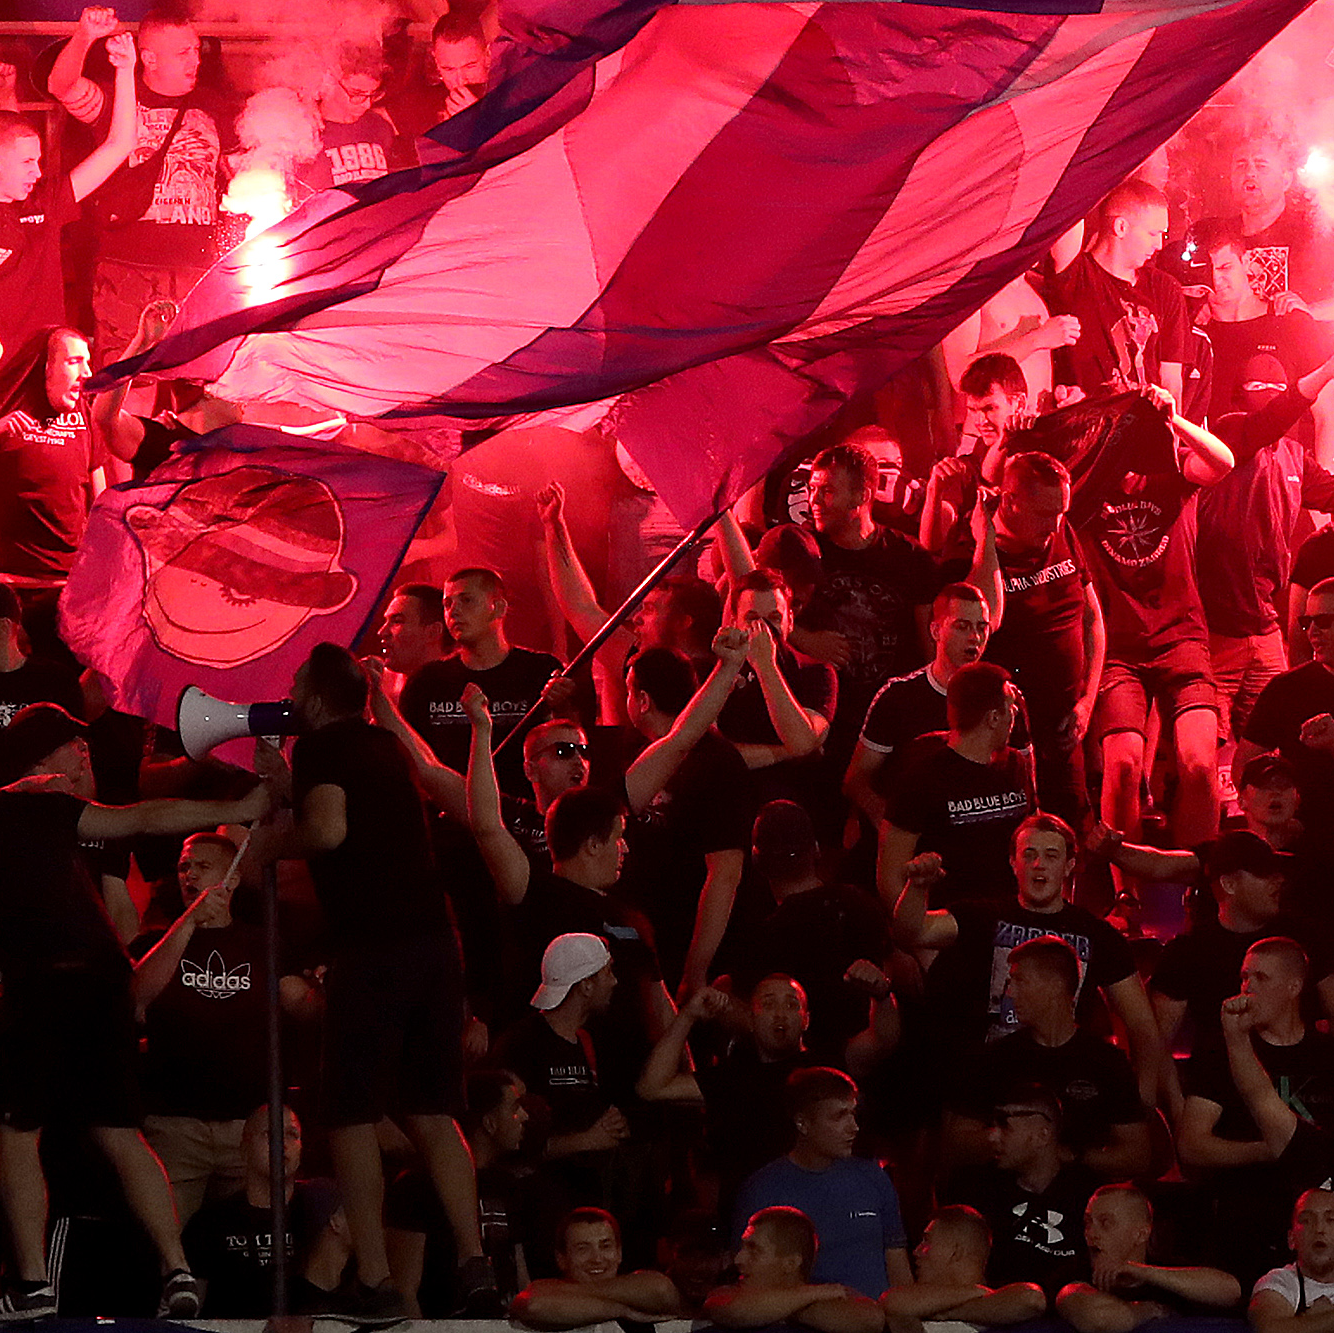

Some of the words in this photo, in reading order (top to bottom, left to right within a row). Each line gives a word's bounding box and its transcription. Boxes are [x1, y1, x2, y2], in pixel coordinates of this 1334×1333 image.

[428, 701, 455, 714] BAD
[947, 798, 976, 814] BAD
[975, 794, 1002, 809] BLUE
[181, 969, 251, 991] adidas
